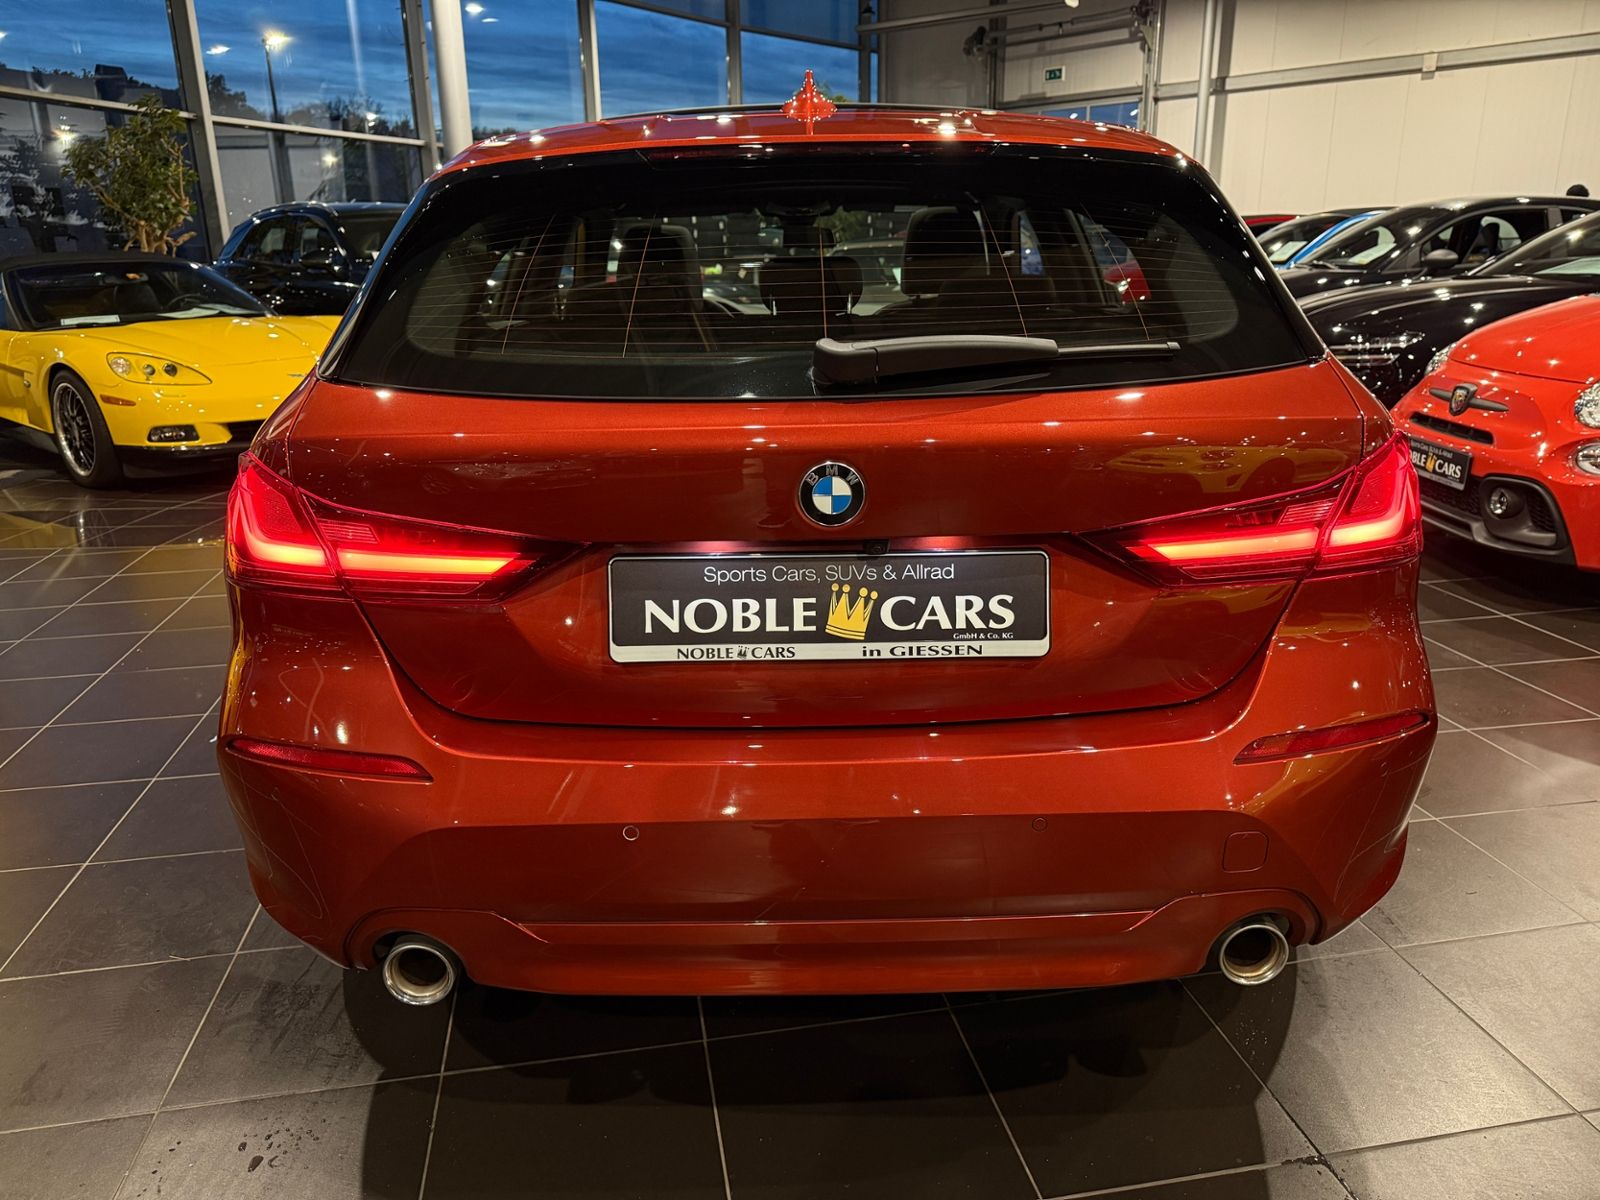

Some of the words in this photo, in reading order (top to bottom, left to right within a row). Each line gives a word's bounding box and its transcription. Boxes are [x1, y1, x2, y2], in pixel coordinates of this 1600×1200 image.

[805, 464, 859, 486] BMW
[1435, 459, 1462, 478] CARS
[703, 565, 766, 586] Sports
[772, 565, 820, 583] Cars,
[825, 564, 877, 581] SUVs
[882, 564, 898, 580] &
[901, 563, 955, 580] Allrad
[644, 597, 817, 634] NOBLE
[879, 594, 1015, 631] CARS
[953, 632, 978, 640] GmbH
[677, 647, 734, 660] NOBLE
[751, 646, 796, 659] CARS
[862, 646, 881, 657] in
[889, 644, 983, 657] GIESSEN
